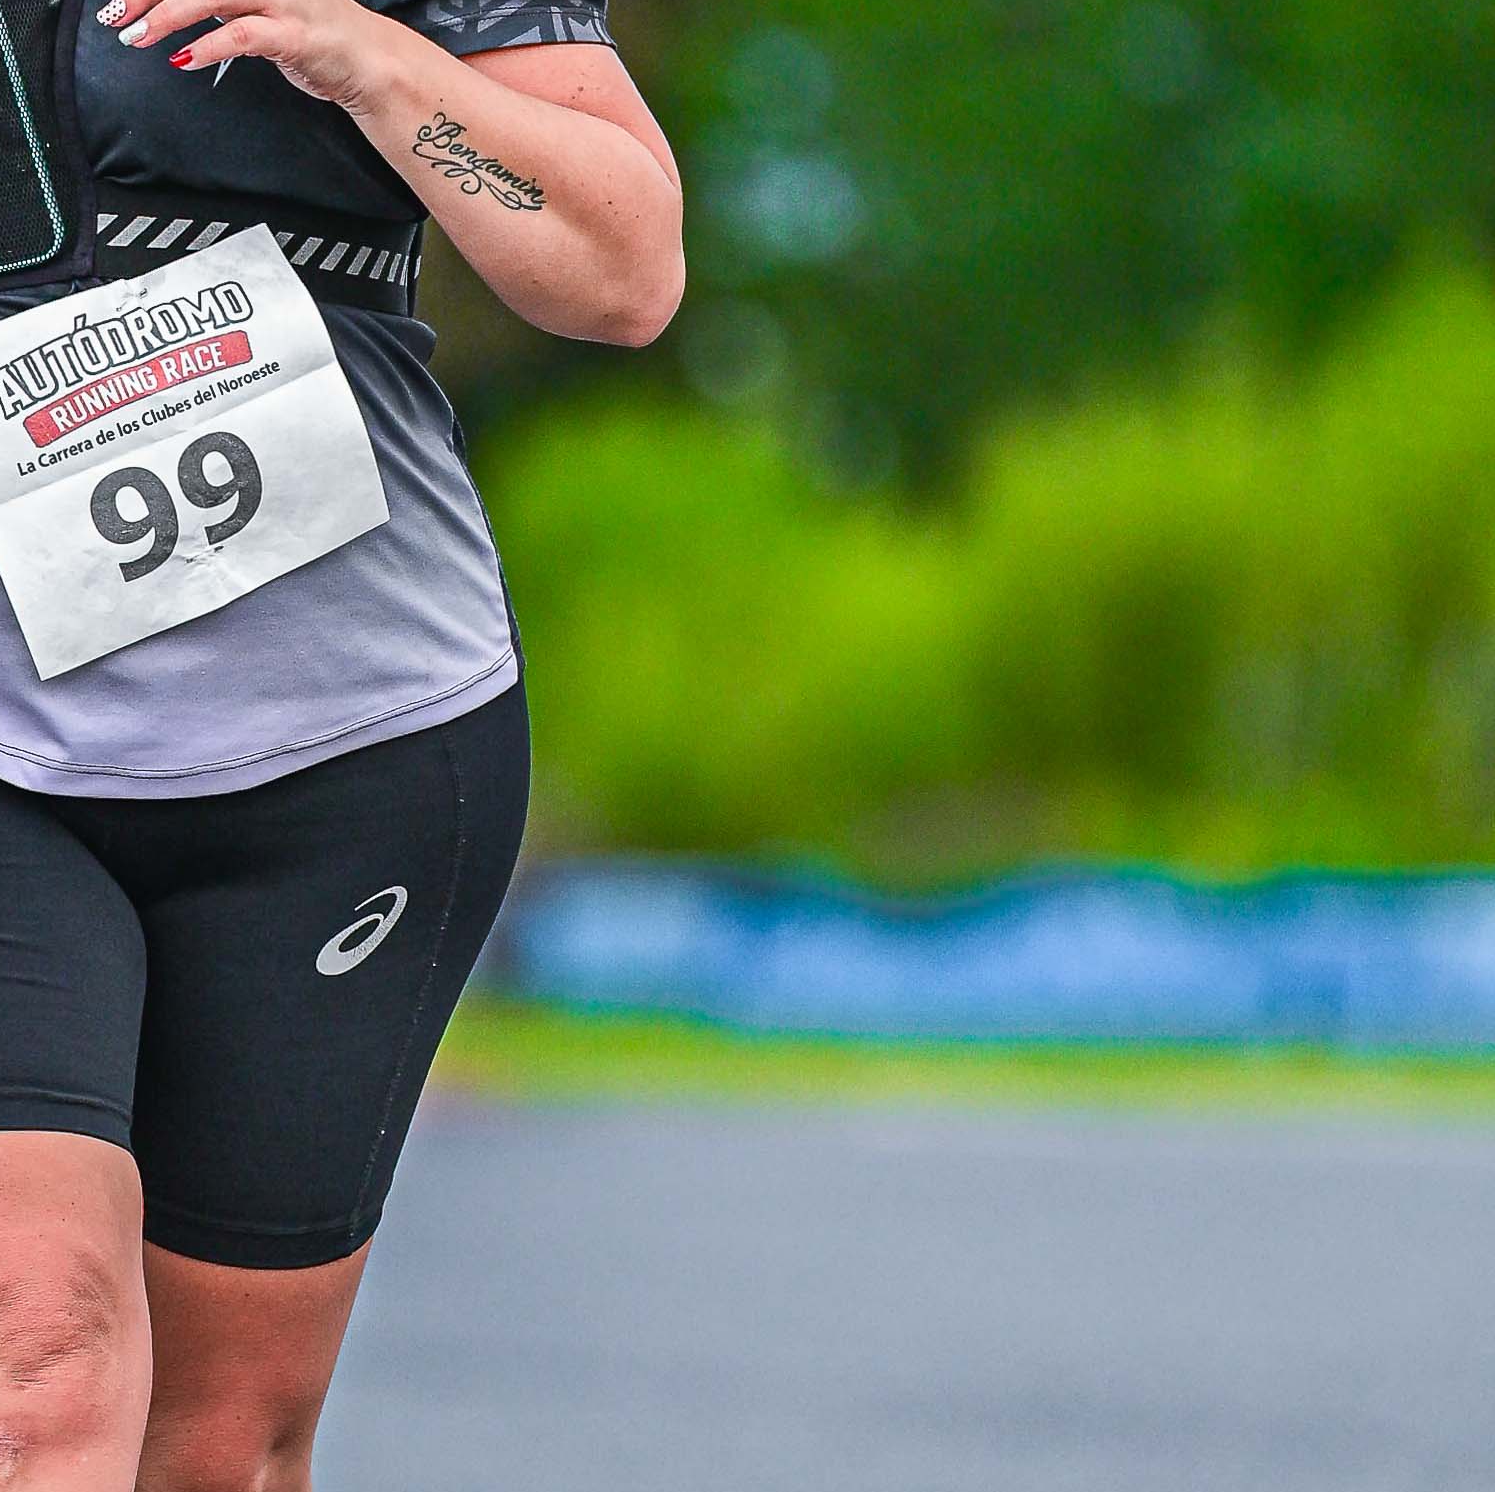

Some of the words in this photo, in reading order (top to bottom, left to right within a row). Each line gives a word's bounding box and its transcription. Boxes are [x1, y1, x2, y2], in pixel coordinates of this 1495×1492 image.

[17, 461, 36, 476] La
[38, 438, 94, 468] Carrera
[95, 427, 115, 444] de
[116, 417, 141, 437] los
[141, 399, 192, 426] Clubes
[193, 385, 217, 406] del
[218, 360, 281, 396] Noroeste
[49, 365, 158, 432] RUNNING
[160, 342, 226, 383] RACE
[91, 432, 262, 582] 99
